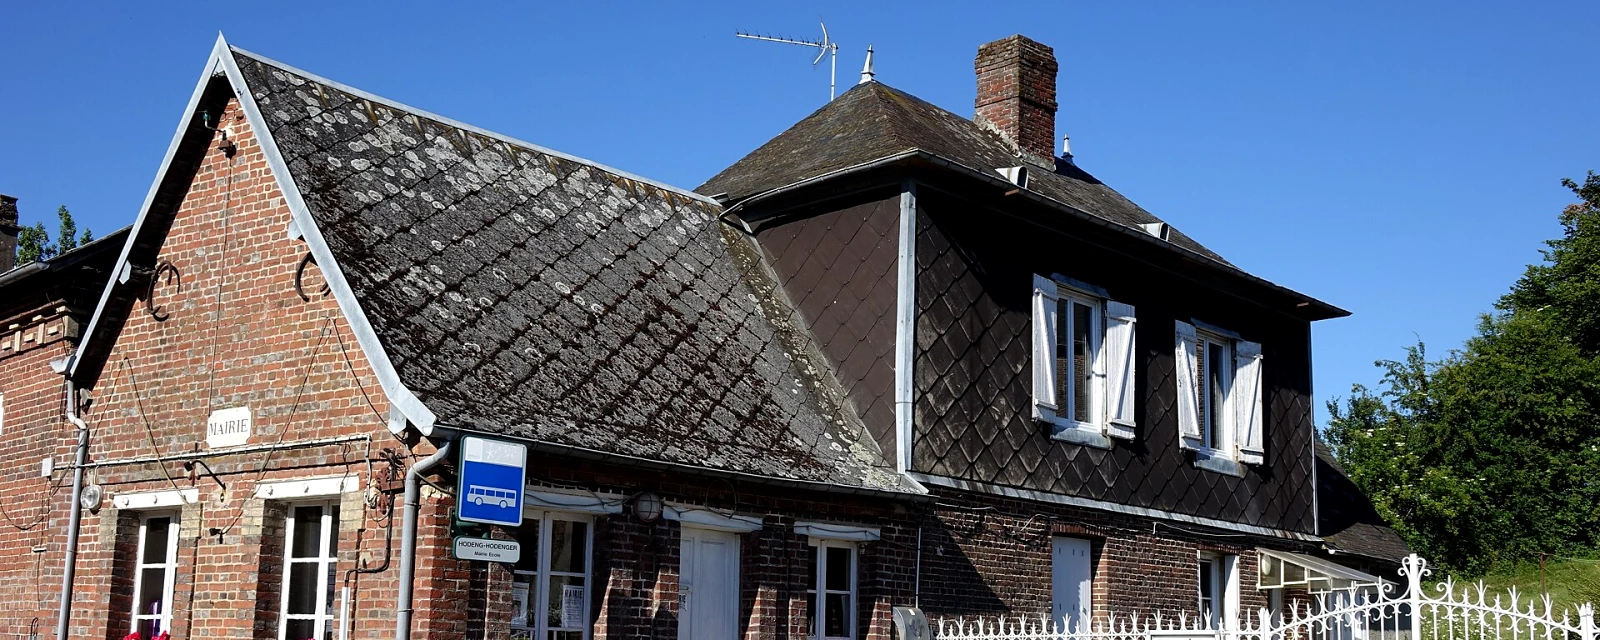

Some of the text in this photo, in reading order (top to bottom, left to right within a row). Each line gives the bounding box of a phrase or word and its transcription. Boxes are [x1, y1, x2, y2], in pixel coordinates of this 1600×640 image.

[208, 418, 249, 436] MAIRIE
[458, 540, 518, 551] HODENG-HODENGER
[564, 589, 583, 599] MAIRIE
